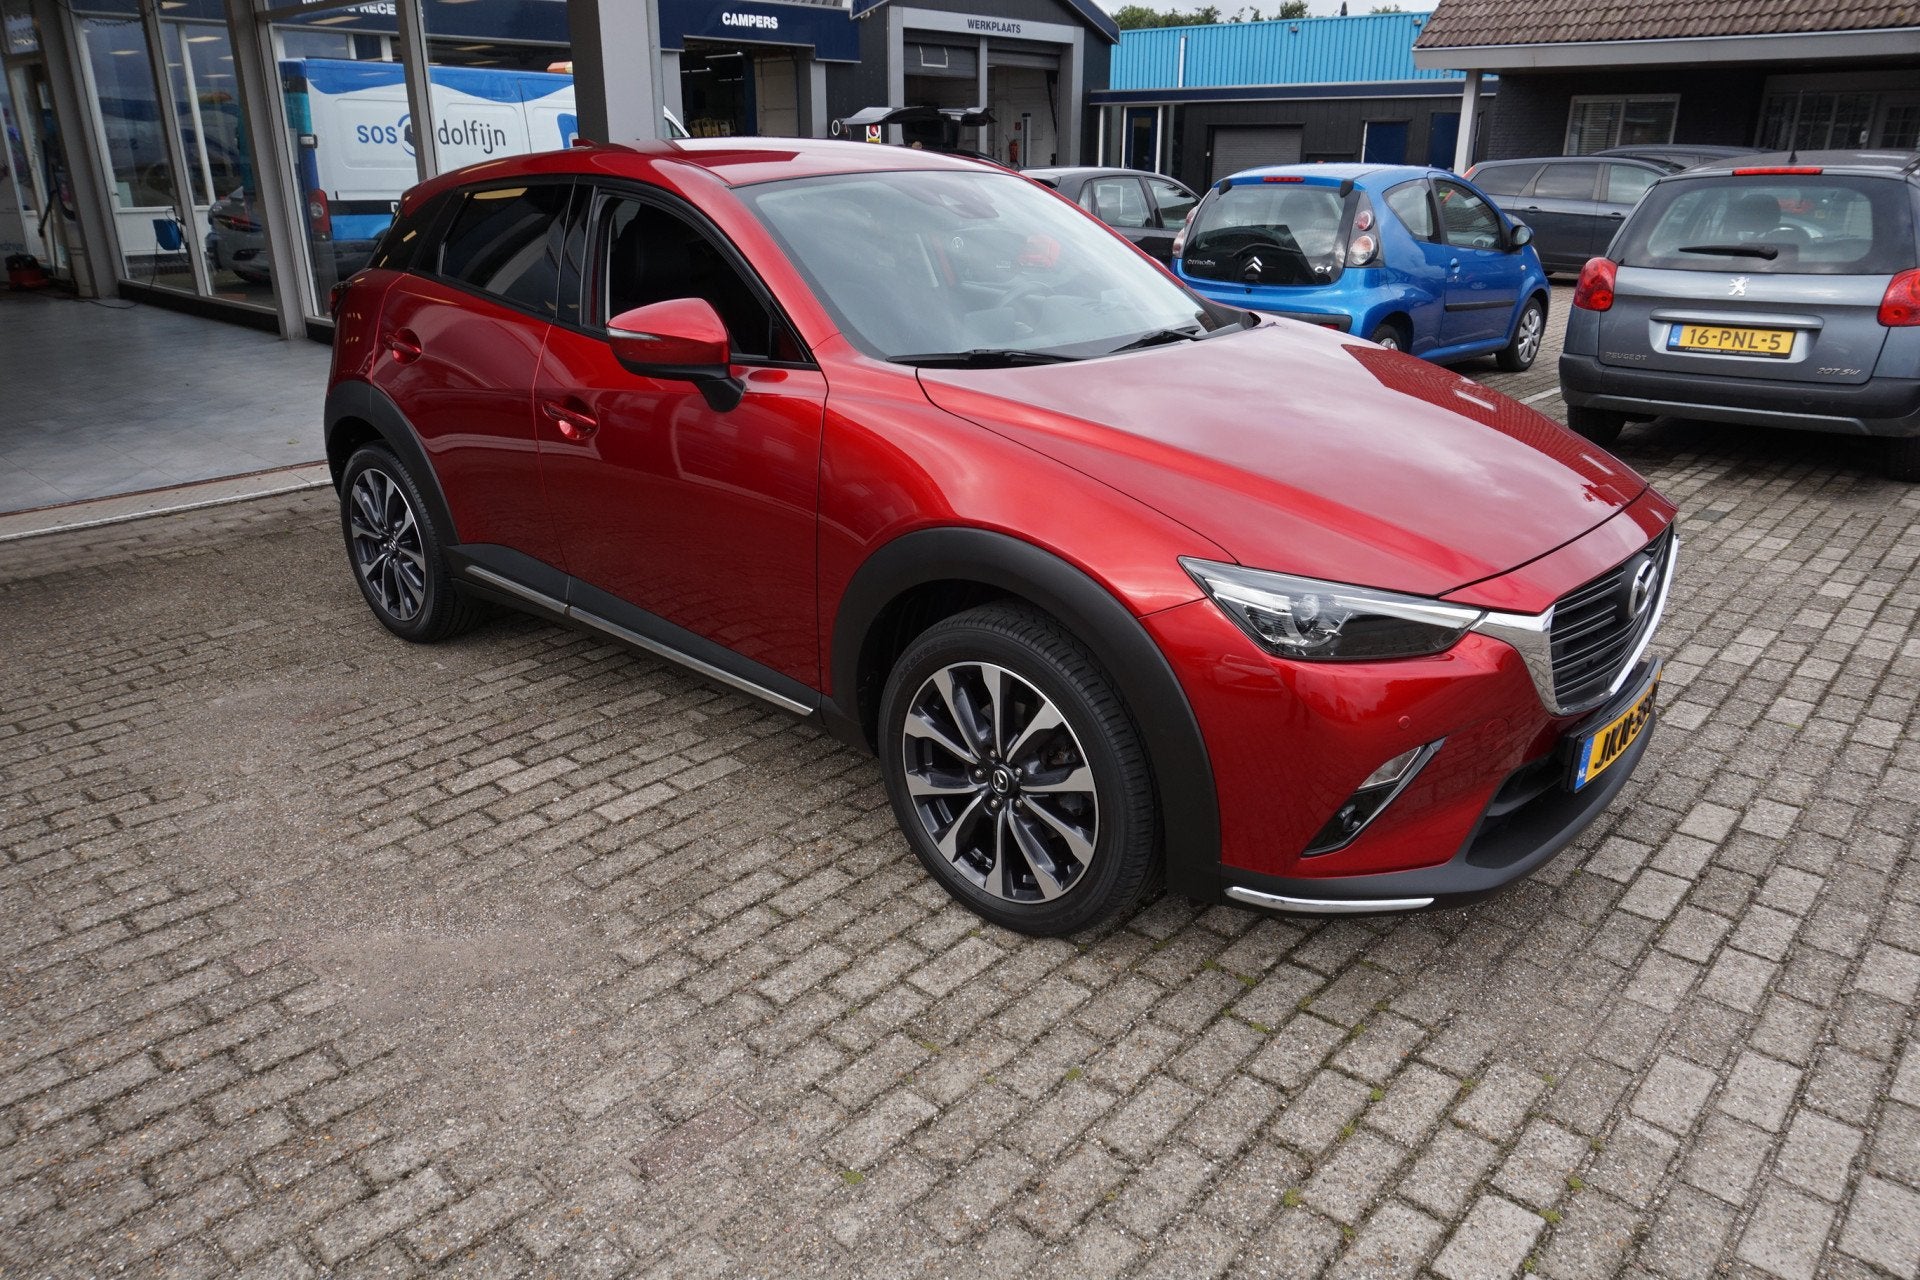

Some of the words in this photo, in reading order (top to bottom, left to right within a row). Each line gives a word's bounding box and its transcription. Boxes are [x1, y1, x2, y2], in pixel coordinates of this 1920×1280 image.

[722, 11, 779, 30] CAMPERS
[967, 18, 1022, 34] WERKPLAATS
[356, 125, 398, 145] sos
[438, 119, 507, 155] dolfijn
[1689, 328, 1782, 351] 16-PNL-5
[1605, 351, 1649, 361] PEUGEOT
